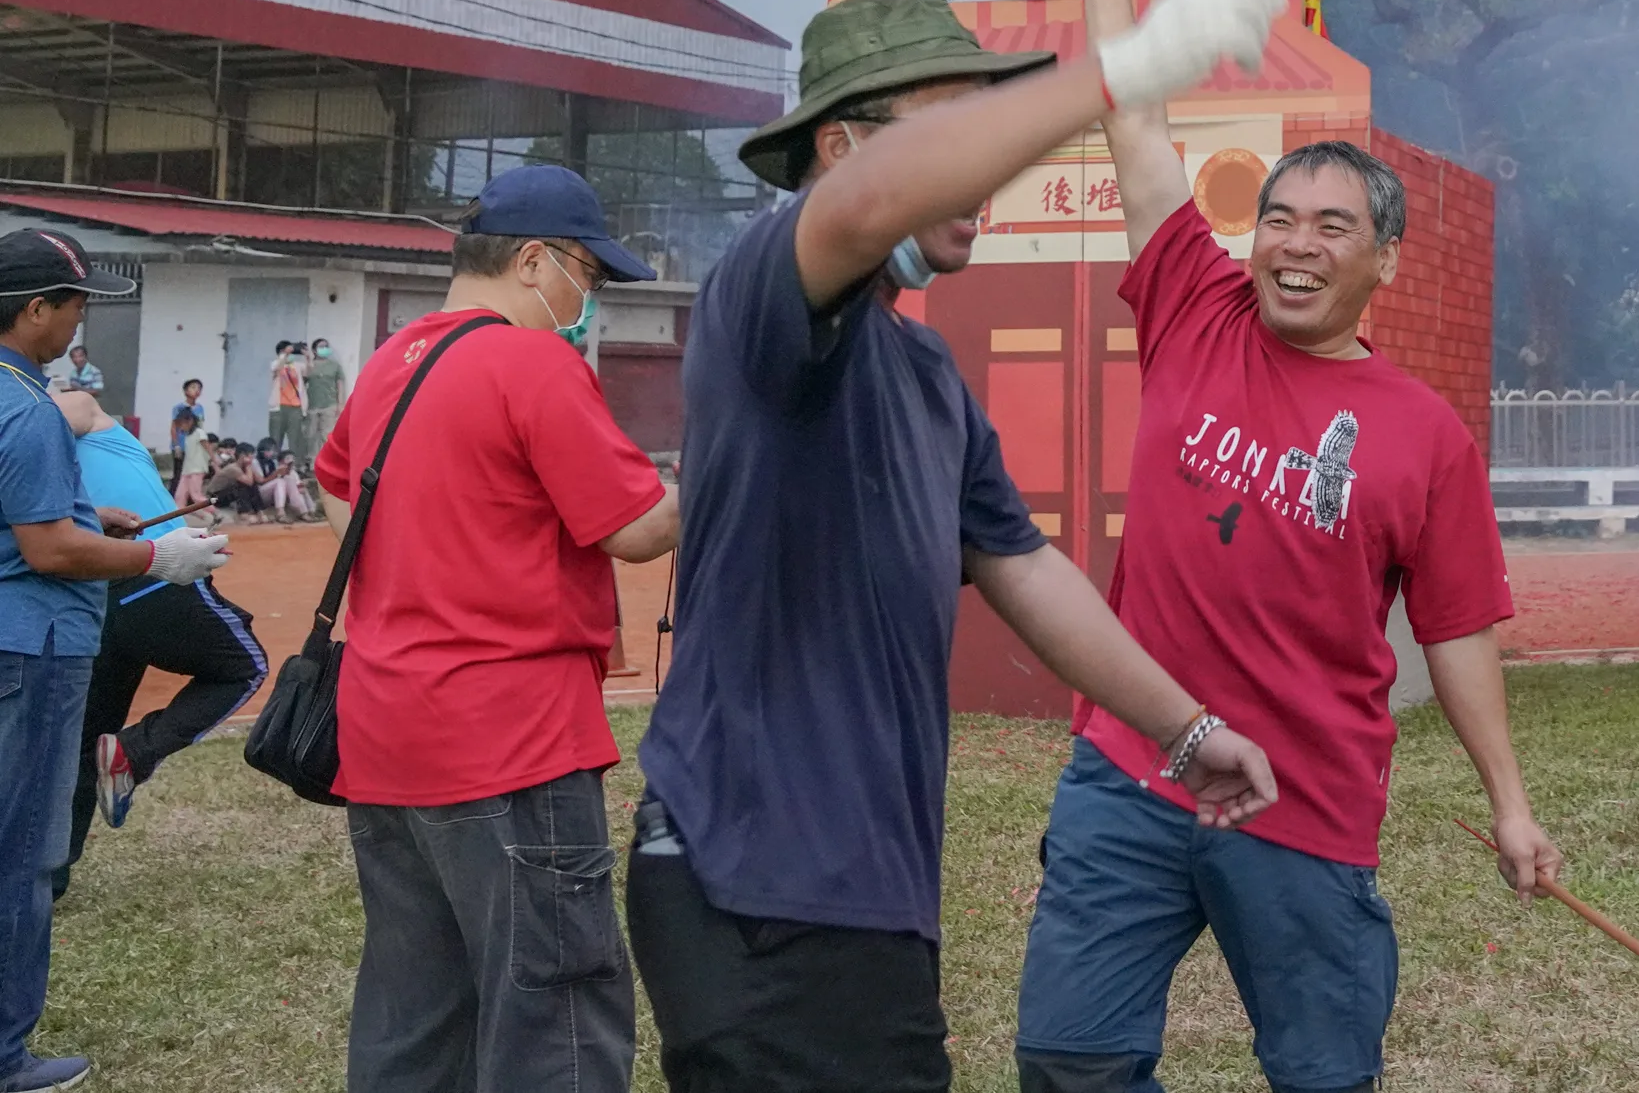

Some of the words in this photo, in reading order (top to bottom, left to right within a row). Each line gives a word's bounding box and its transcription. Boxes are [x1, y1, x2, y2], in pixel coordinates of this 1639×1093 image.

[1041, 175, 1123, 216] 後堆
[1178, 447, 1252, 494] RAPTORS
[1260, 490, 1346, 541] FESTIAL
